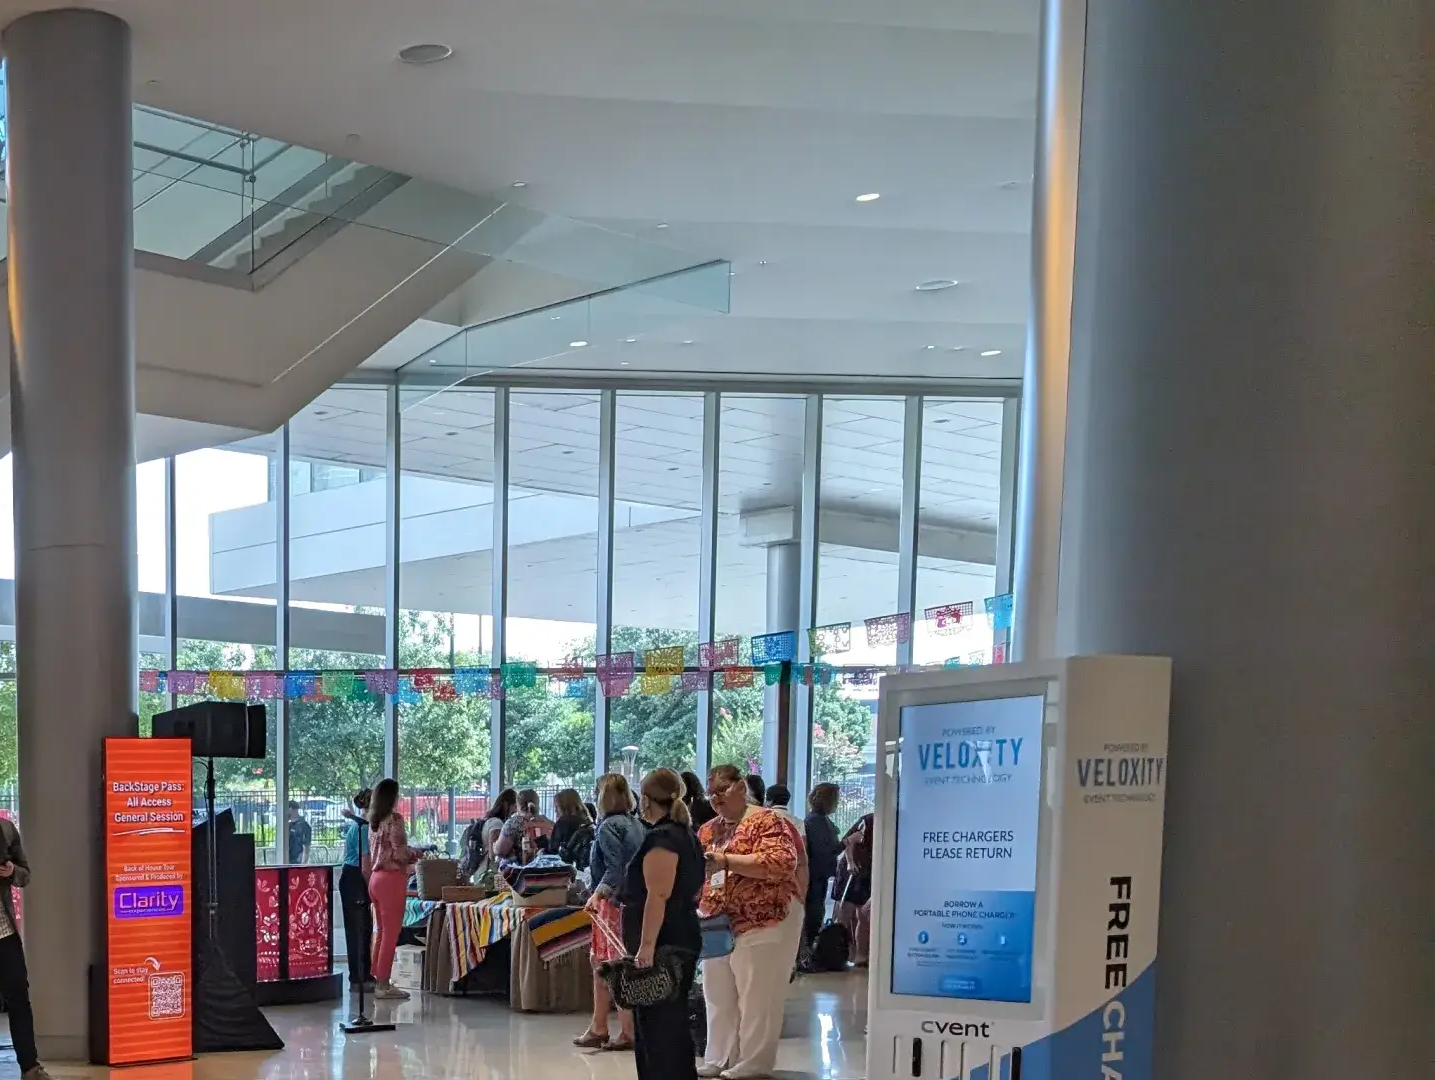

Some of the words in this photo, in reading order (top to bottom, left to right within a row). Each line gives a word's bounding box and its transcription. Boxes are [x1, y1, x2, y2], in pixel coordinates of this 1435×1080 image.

[918, 738, 1024, 771] VELOXTY
[1077, 757, 1163, 787] VELOXITY
[951, 774, 1013, 785] TECHNOOGY
[112, 782, 159, 794] BackStage
[161, 782, 185, 792] Pass:
[126, 797, 139, 807] All
[140, 797, 172, 807] Access
[114, 812, 148, 823] General
[150, 812, 184, 822] Session
[923, 832, 949, 842] FREE
[952, 831, 1014, 842] CHARGERS
[923, 848, 962, 859] PLEASE
[965, 848, 1012, 859] RETURN
[119, 891, 179, 911] Clarity
[944, 900, 977, 908] BORROW
[914, 910, 951, 918] PORTABLE
[1104, 876, 1132, 990] FREE
[921, 1020, 990, 1038] cvent
